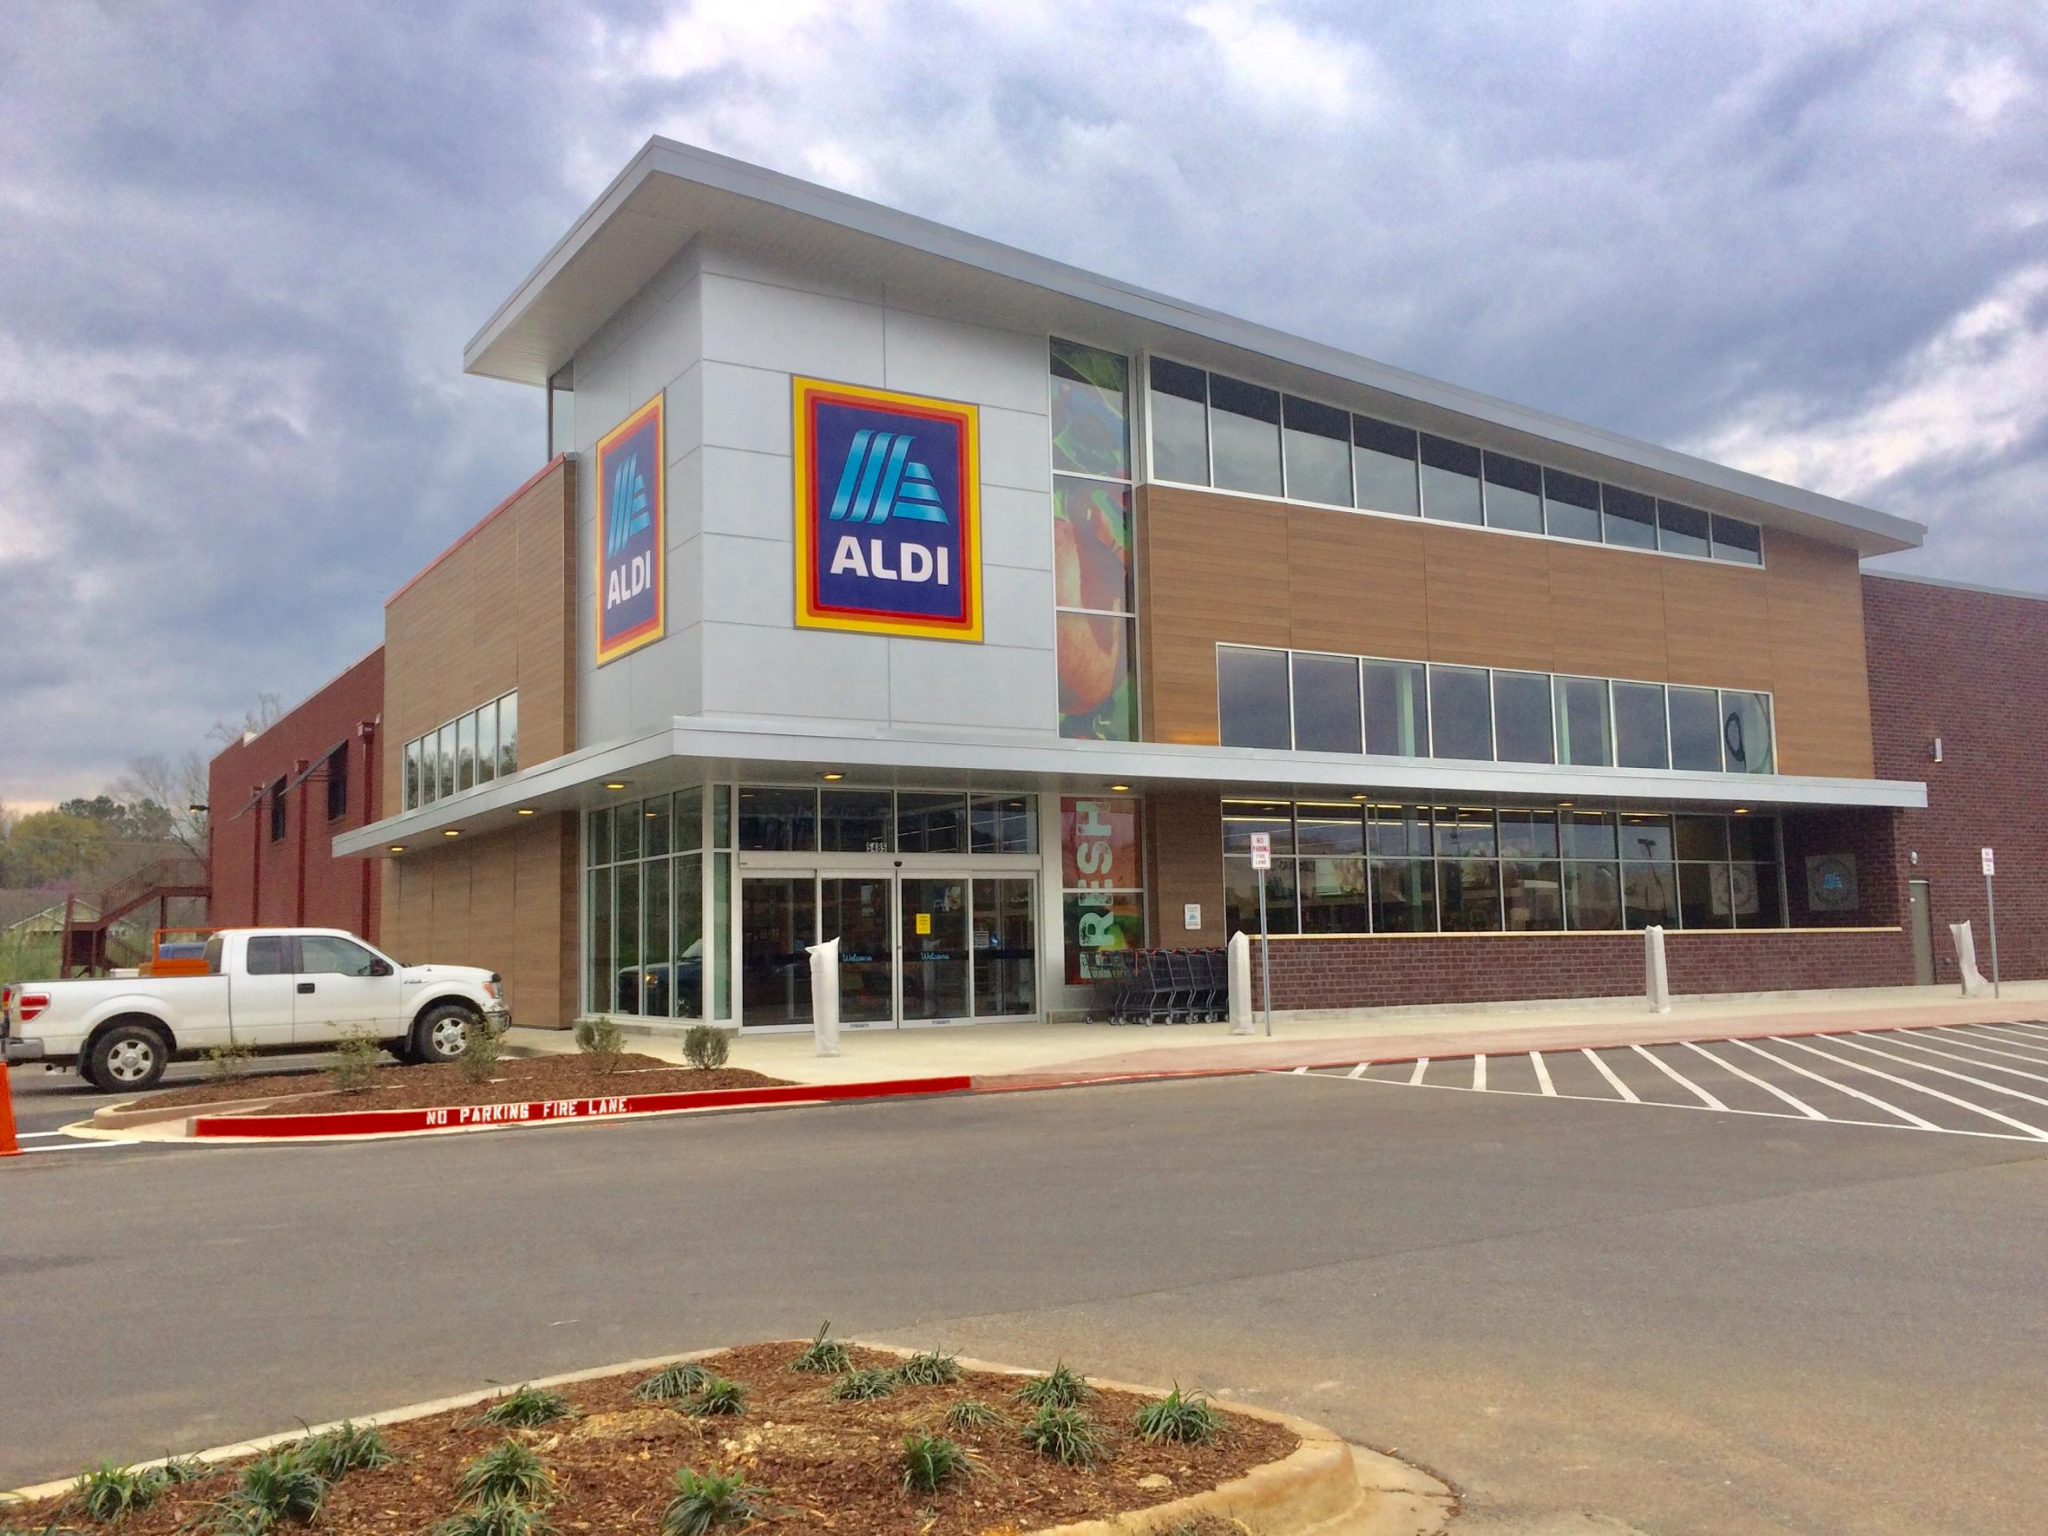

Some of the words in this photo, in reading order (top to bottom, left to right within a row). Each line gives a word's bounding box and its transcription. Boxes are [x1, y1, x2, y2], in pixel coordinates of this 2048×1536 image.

[830, 535, 949, 585] ALDI
[607, 550, 650, 610] ALDI
[1075, 801, 1116, 979] FRESH
[842, 953, 873, 962] Welcome
[920, 952, 950, 960] Welcome
[426, 1111, 447, 1125] NO
[460, 1103, 529, 1123] PARKING
[543, 1101, 578, 1117] FIRE
[589, 1098, 628, 1115] LANE
